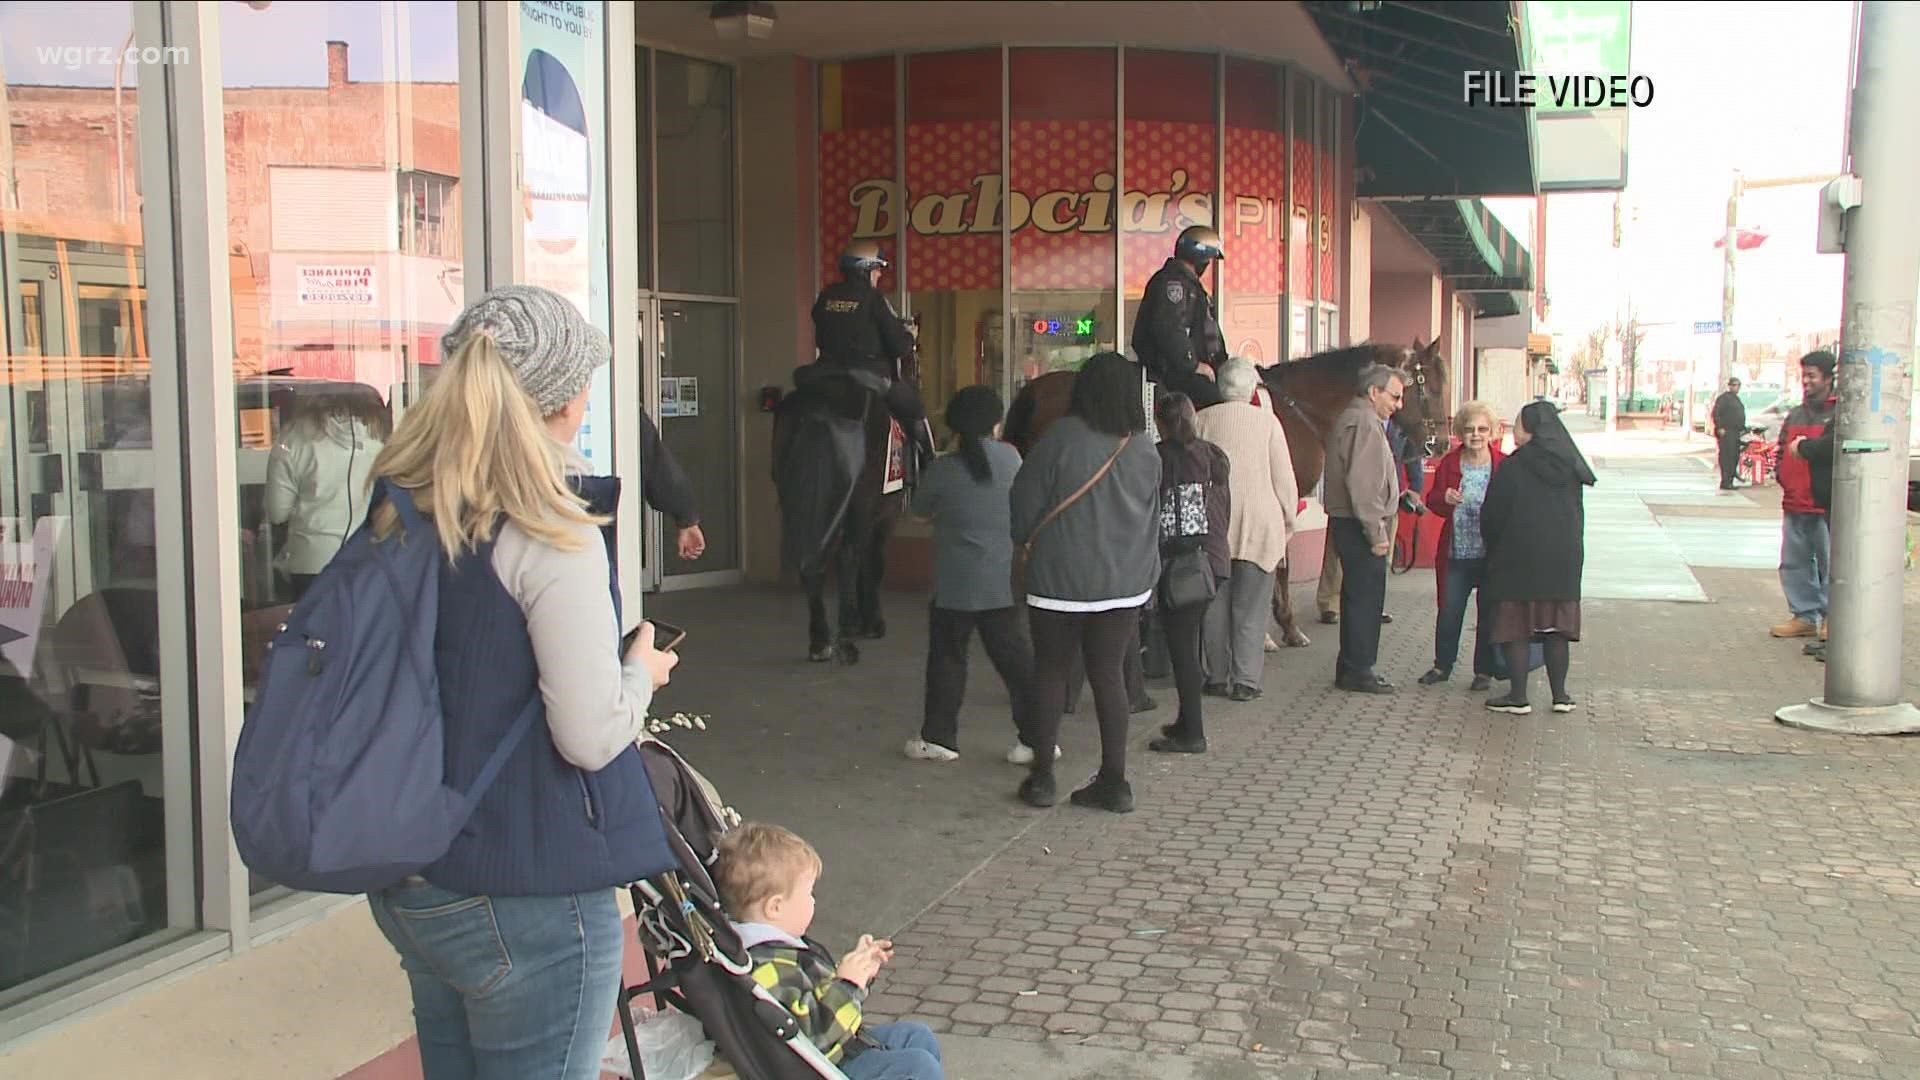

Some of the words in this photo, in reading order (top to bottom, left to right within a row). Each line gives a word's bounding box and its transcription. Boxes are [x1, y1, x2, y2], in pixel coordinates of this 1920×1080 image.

[549, 15, 563, 30] TO
[564, 20, 582, 36] YOU
[850, 169, 1213, 239] Babcia's
[1234, 195, 1332, 256] PIGI
[1033, 320, 1093, 335] OPN
